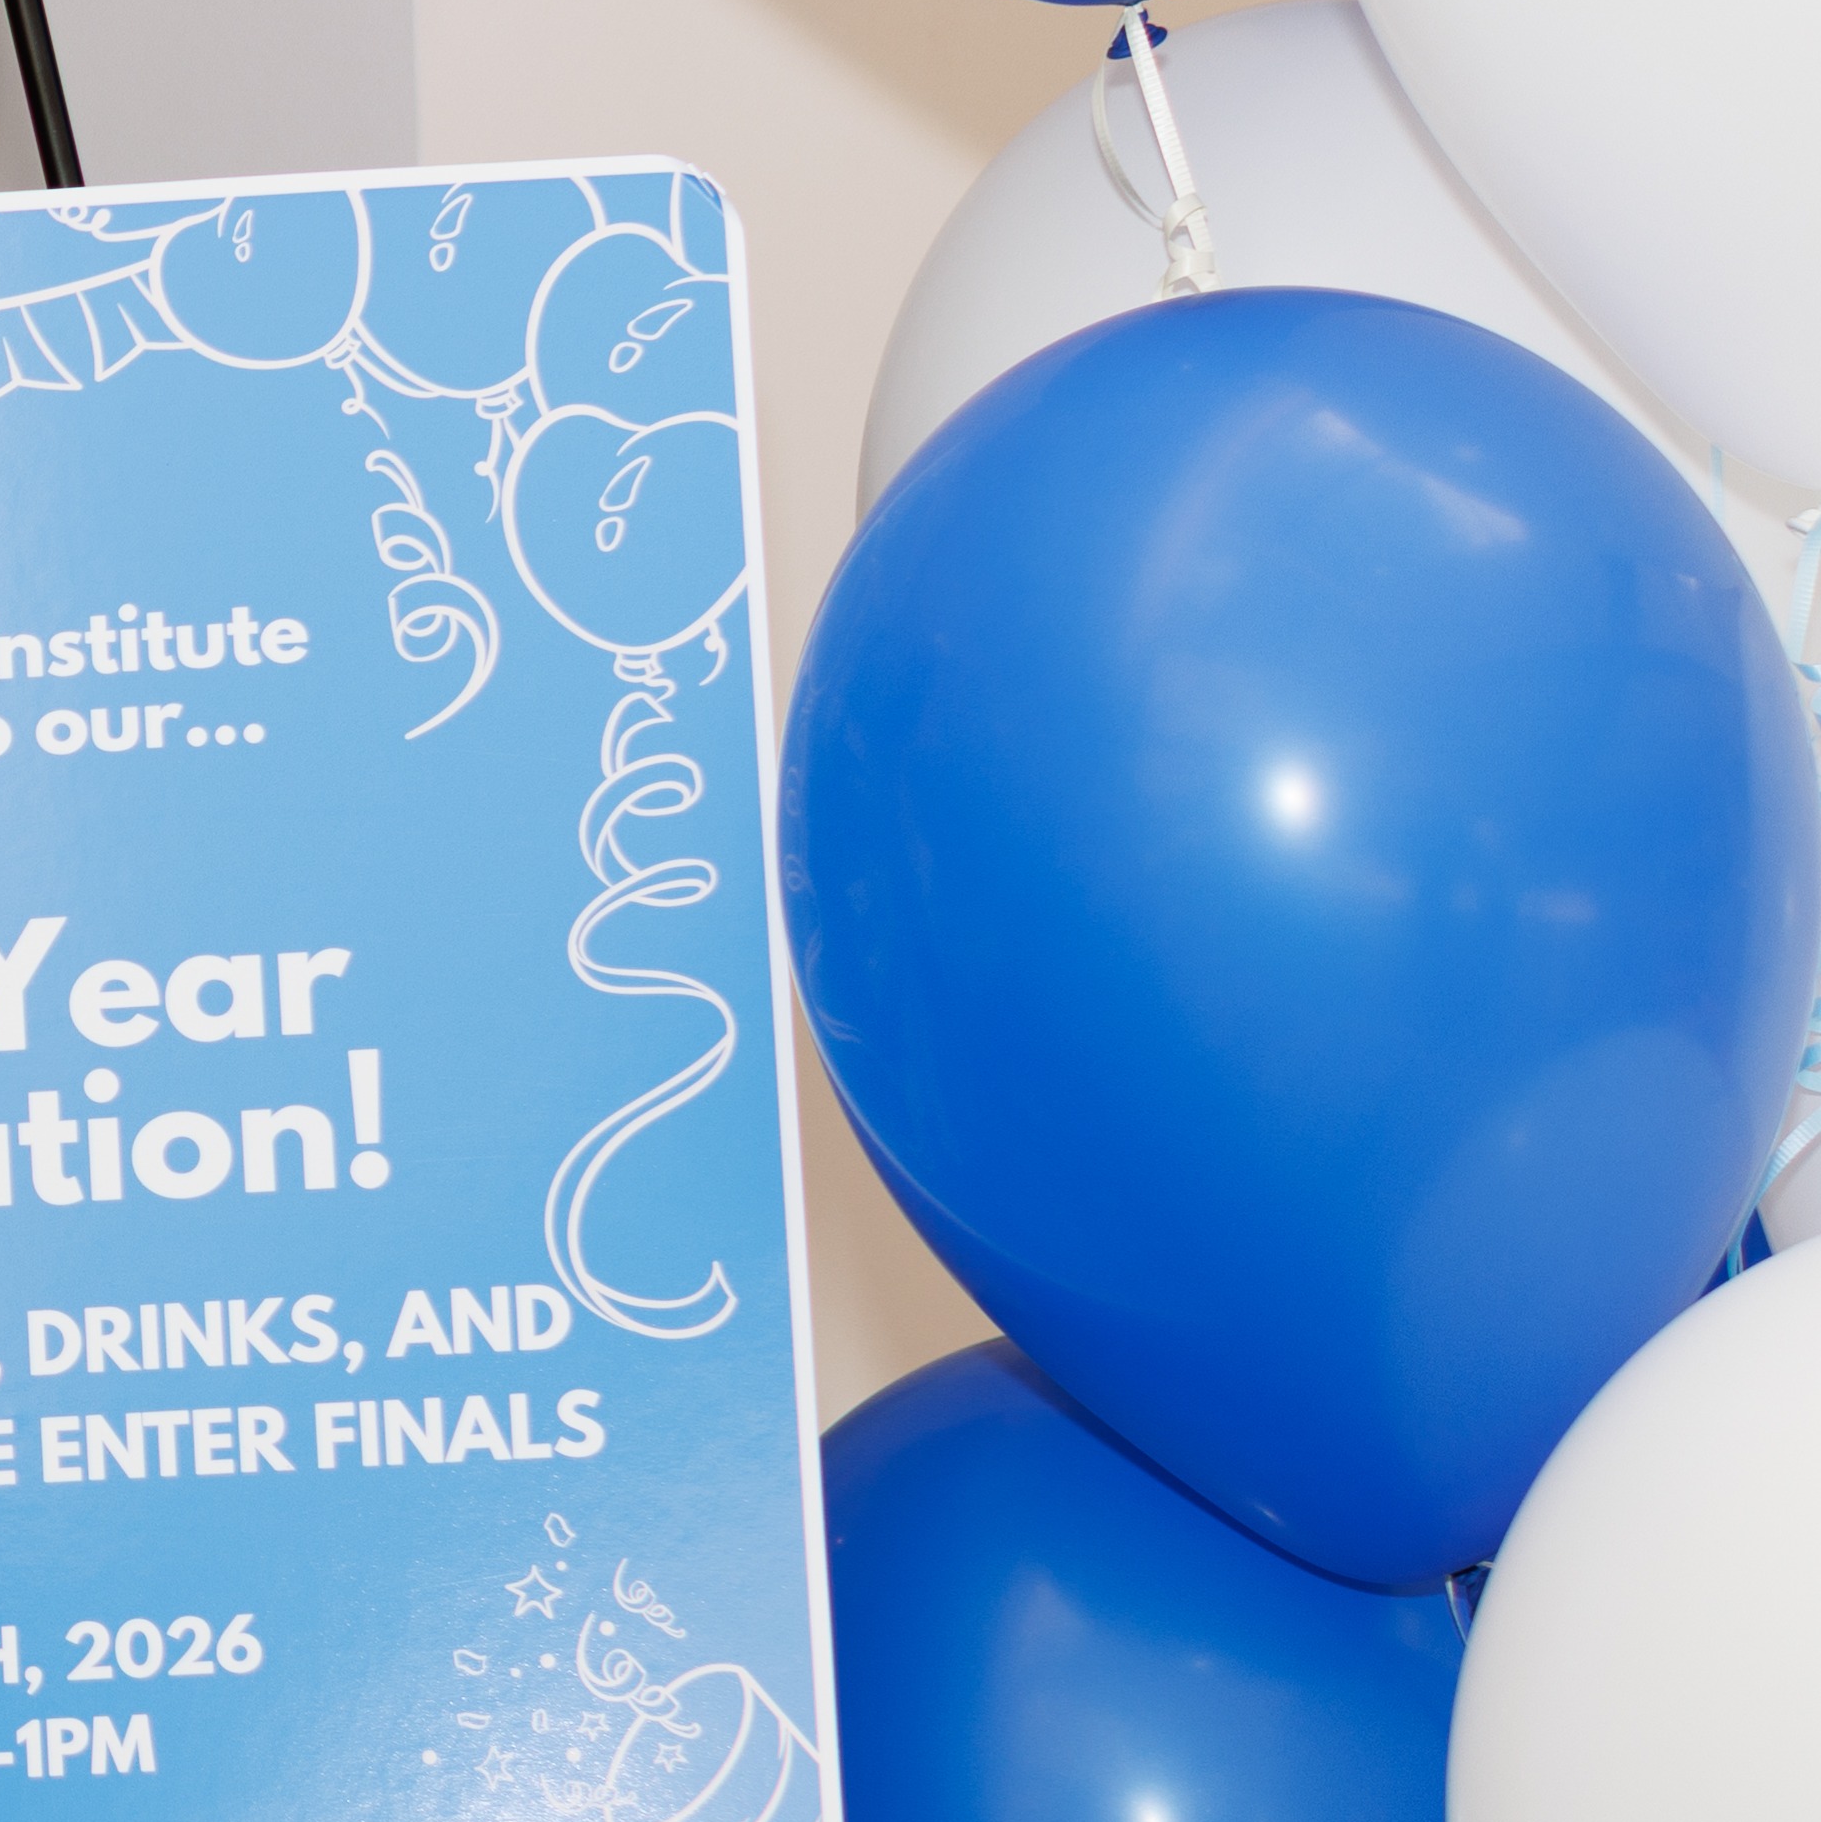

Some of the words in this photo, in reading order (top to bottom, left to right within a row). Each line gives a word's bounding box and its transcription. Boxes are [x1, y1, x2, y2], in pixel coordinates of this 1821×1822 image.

[35, 705, 267, 758] our...
[26, 1293, 366, 1378] DRINKS,
[385, 1283, 573, 1359] AND
[39, 1404, 296, 1484] ENTER
[313, 1387, 607, 1470] FINALS
[64, 1612, 264, 1682] 2026
